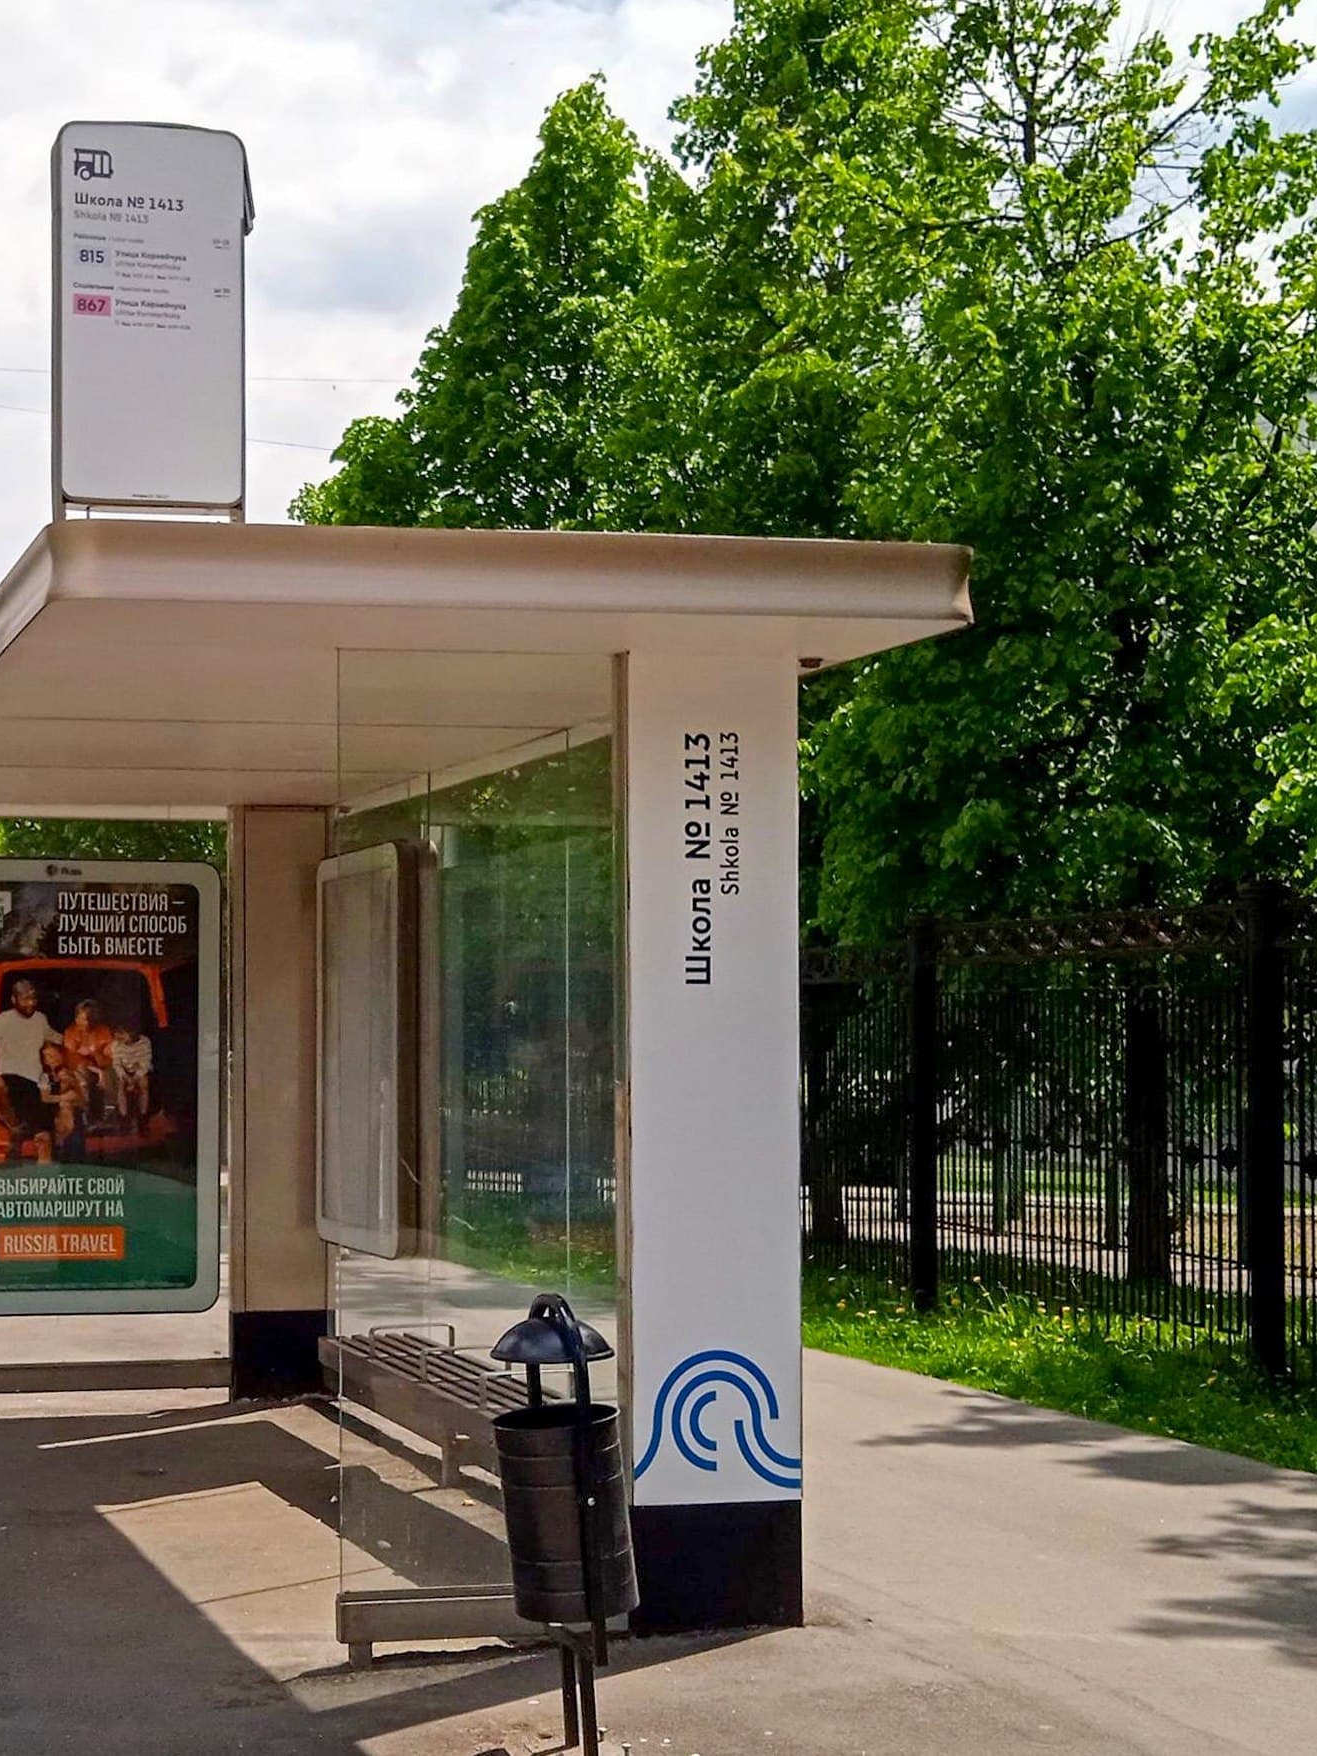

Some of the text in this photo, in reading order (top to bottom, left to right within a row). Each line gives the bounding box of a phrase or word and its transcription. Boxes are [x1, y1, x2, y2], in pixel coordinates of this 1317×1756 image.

[74, 192, 184, 212] Школа № 1413
[74, 209, 107, 222] Shkola
[125, 213, 149, 224] 1413
[79, 249, 105, 264] 815
[76, 298, 106, 313] 867
[720, 732, 739, 895] Shkola № 1413
[685, 733, 711, 985] Школа № 1413
[57, 891, 169, 911] ПУТЕШЕСТВИЯ
[57, 910, 187, 934] ЛУЧШИЙ СПОСОБ
[57, 936, 164, 956] БЫТЬ ВМЕСТЕ
[87, 1174, 125, 1195] СВОЙ
[105, 1200, 124, 1217] НА
[3, 1233, 117, 1253] RUSSIA.TRAVEL
